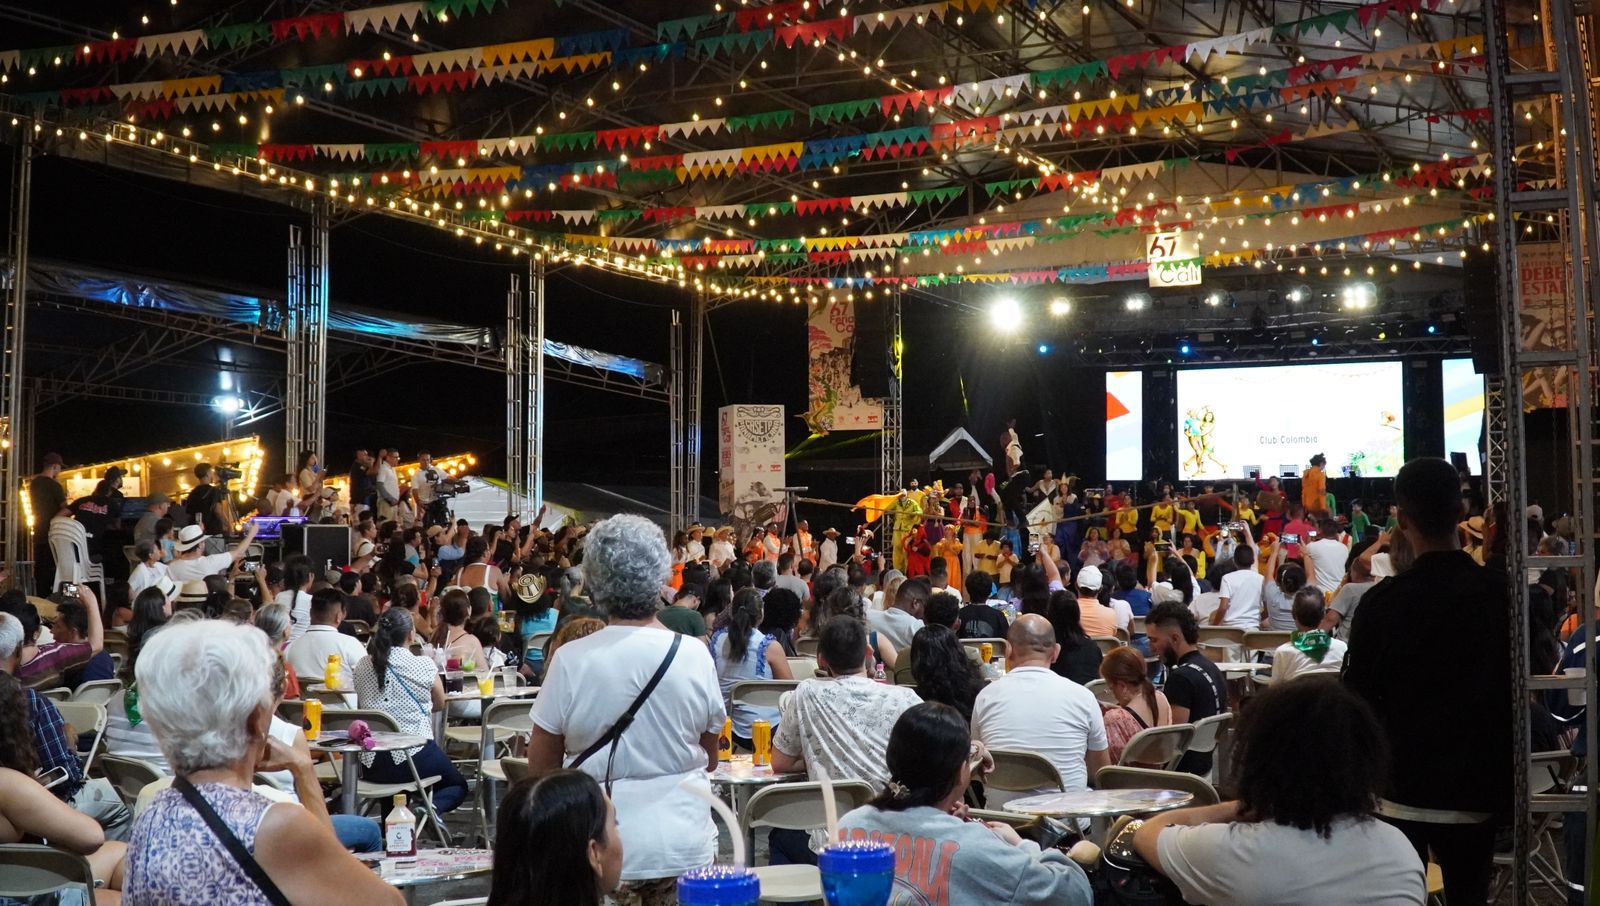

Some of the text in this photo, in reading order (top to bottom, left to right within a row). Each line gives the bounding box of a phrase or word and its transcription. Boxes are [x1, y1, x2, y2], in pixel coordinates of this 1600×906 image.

[1150, 235, 1177, 257] 67
[1160, 265, 1198, 283] Cali
[830, 301, 848, 316] 67
[1259, 434, 1318, 445] Club Colombia
